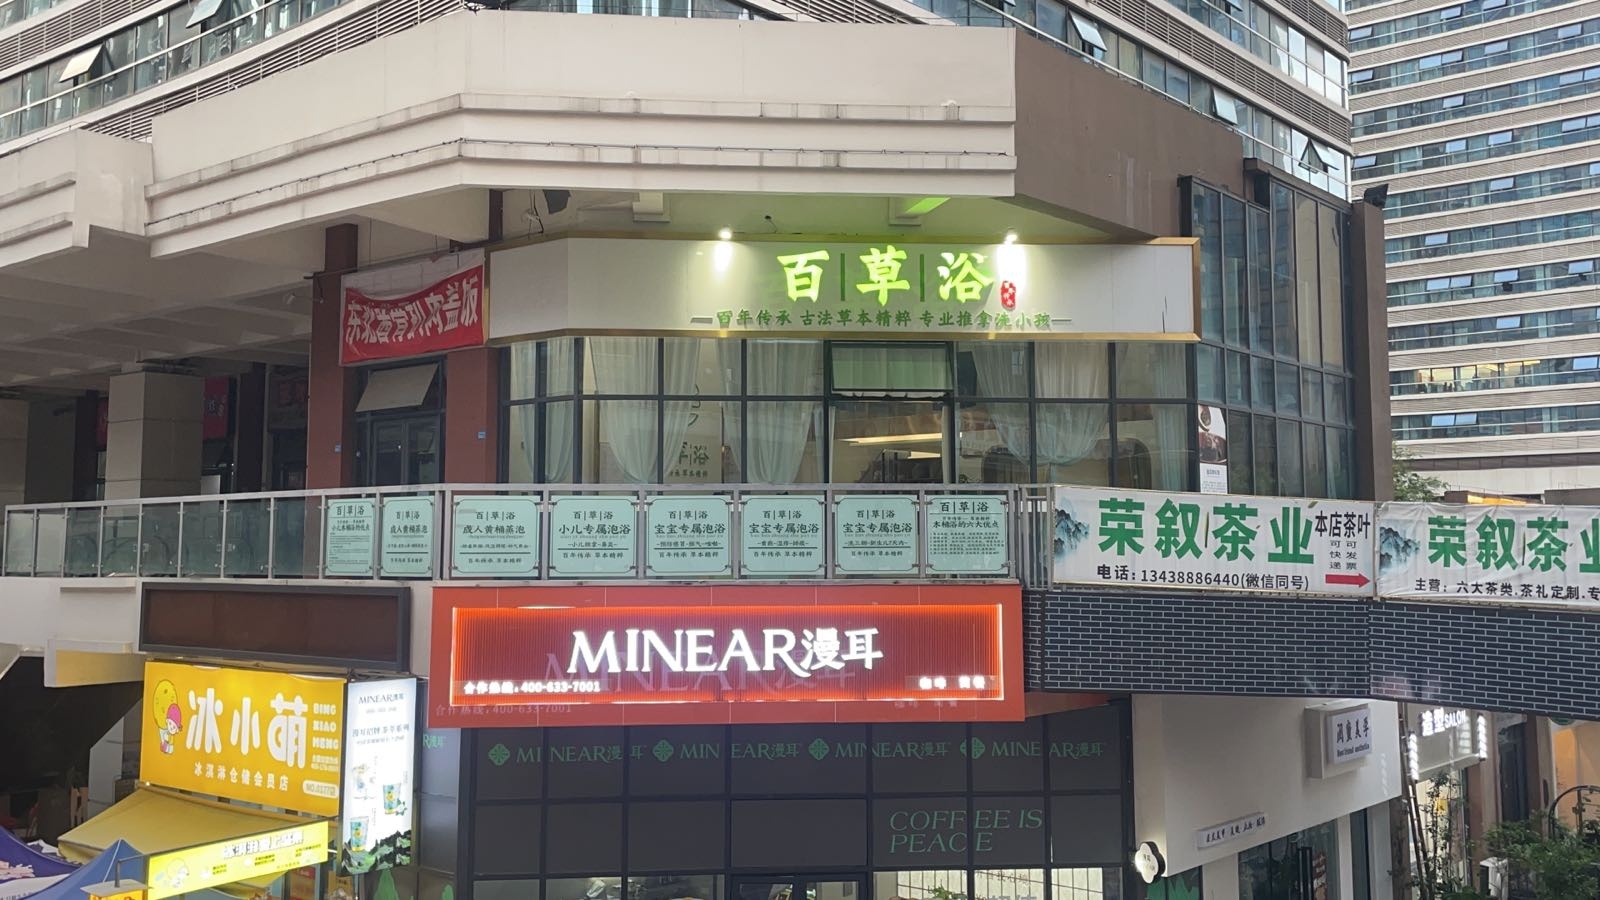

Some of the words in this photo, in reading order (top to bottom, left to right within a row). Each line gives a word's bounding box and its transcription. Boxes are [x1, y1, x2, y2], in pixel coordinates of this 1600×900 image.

[717, 309, 792, 326] 百年传承
[800, 310, 912, 327] 古法草本精粹
[920, 310, 1050, 328] 专业推拿洗小孩
[462, 524, 526, 535] 成人黄桶蒸泡
[558, 523, 631, 535] 小儿专属泡浴
[654, 523, 725, 534] 宝宝专属泡浴
[749, 522, 819, 534] 宝宝专属泡浴
[843, 522, 912, 533] 宝宝专属泡浴
[933, 520, 999, 528] 木桶浴的六大优点
[1098, 498, 1315, 565] 荣叙茶业
[1315, 510, 1371, 540] 本店茶叶
[313, 703, 336, 716] BING
[185, 686, 308, 769] 冰小萌
[193, 761, 289, 792] 冰淇淋仓储会员店
[889, 809, 1010, 831] COFFEE
[1018, 809, 1043, 829] IS
[889, 832, 993, 853] PEACE
